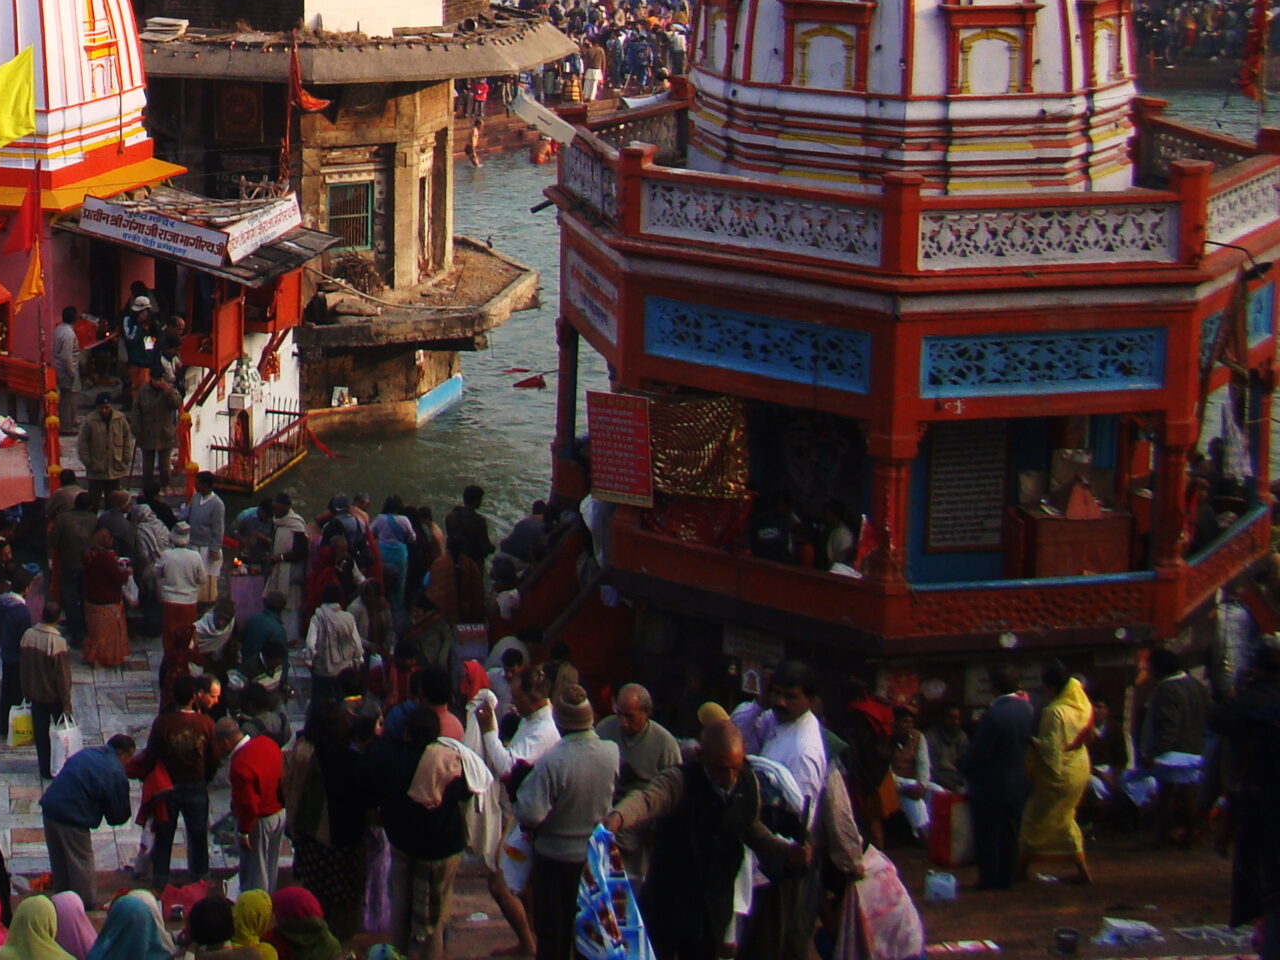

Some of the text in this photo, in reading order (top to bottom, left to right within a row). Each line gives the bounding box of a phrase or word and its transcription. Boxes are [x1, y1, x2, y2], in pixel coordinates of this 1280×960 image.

[82, 207, 110, 225] प्राचीन
[110, 213, 123, 229] श्री
[123, 217, 145, 234] गंगा
[145, 222, 158, 238] जी
[159, 228, 179, 244] राजा
[179, 234, 215, 253] भागीरथ
[214, 241, 225, 256] जी
